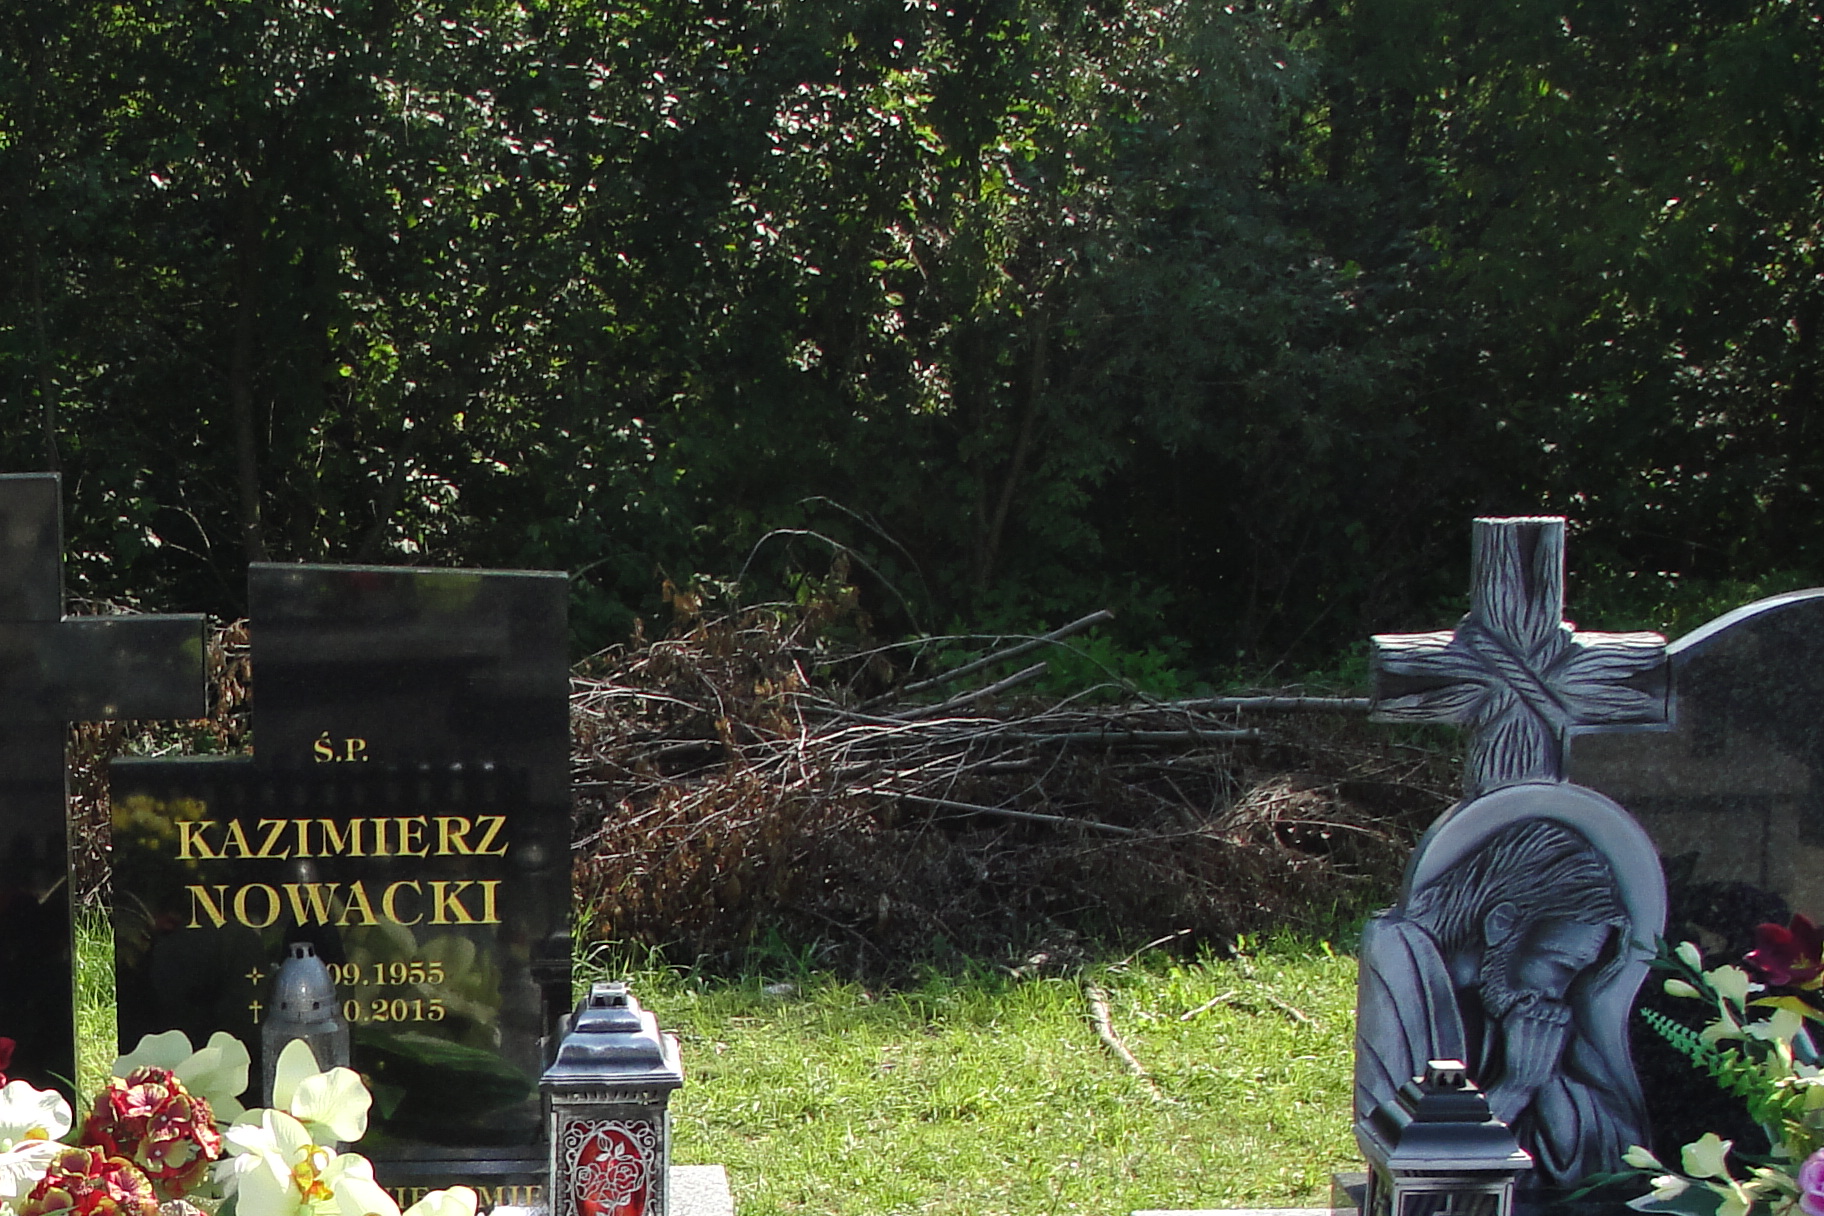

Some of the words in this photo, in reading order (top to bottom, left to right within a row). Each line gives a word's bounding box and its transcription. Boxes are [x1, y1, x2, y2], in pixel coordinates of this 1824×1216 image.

[313, 731, 370, 763] Ś.P.
[174, 814, 510, 861] KAZIMIERZ
[184, 879, 503, 930] NOWACKI
